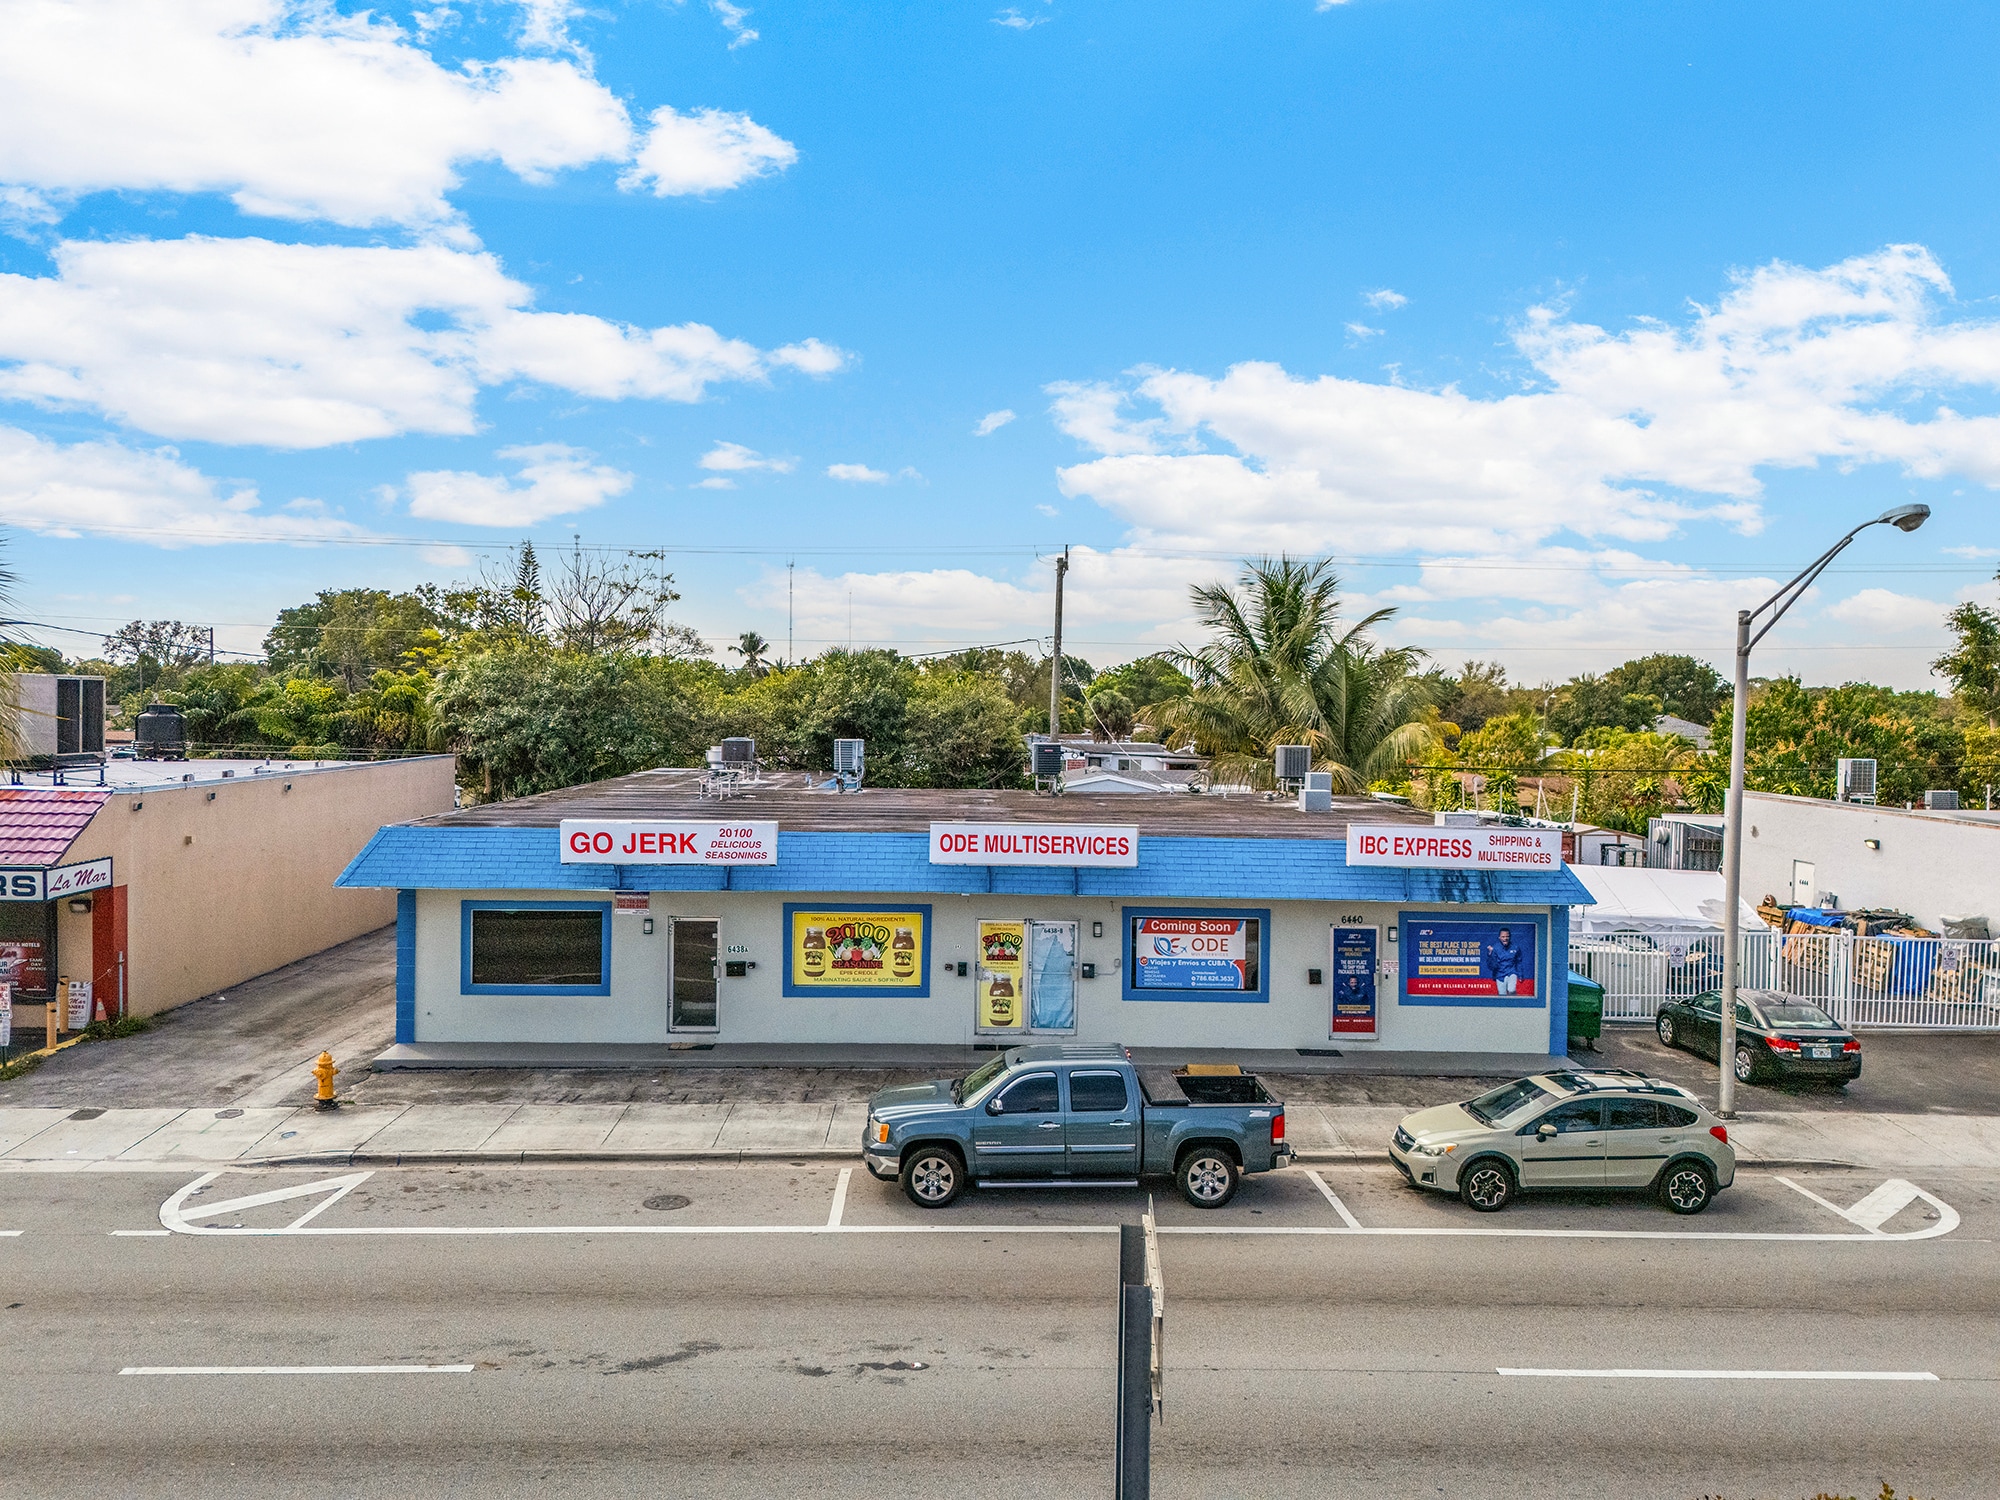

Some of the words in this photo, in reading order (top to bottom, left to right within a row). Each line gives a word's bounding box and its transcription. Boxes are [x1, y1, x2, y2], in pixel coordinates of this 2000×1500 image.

[719, 828, 753, 838] 20100
[569, 831, 613, 854] GO
[622, 832, 698, 854] JERK
[710, 840, 762, 849] DELICIOUS
[939, 833, 979, 853] ODE
[984, 834, 1129, 856] MULTISERVICES
[1359, 835, 1388, 856] IBC
[1394, 836, 1472, 859] EXPRESS
[1488, 834, 1533, 847] SHIPPING
[1535, 836, 1542, 848] &
[704, 851, 768, 860] SEASONINGS
[1478, 850, 1552, 864] MULTISERVICES
[0, 875, 36, 897] S
[49, 873, 71, 892] La
[74, 868, 107, 887] Mar
[1341, 915, 1363, 924] 6440
[825, 922, 890, 945] 20100
[1151, 920, 1196, 934] Coming
[1200, 920, 1231, 932] Soon
[982, 932, 1023, 946] 20100
[1191, 937, 1229, 952] ODE
[832, 959, 883, 969] SEASONING
[1150, 959, 1171, 967] Viajes
